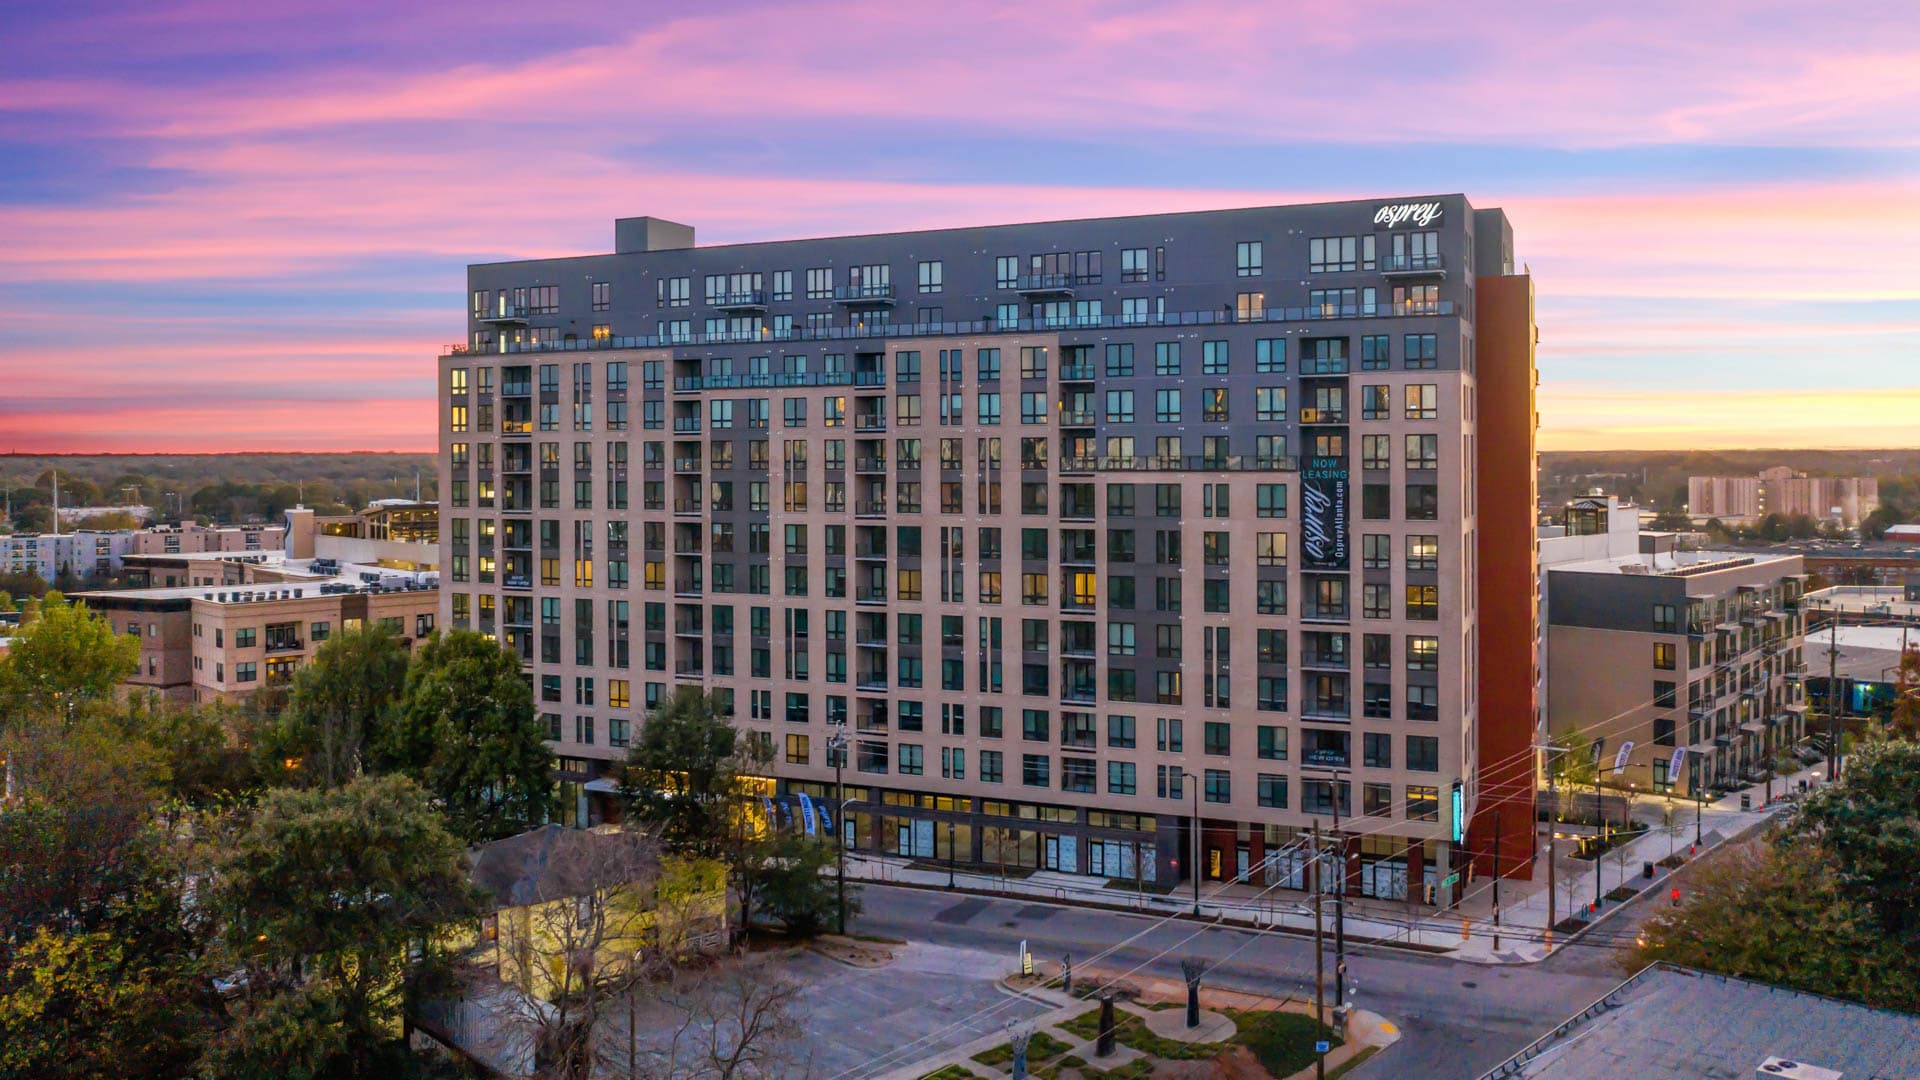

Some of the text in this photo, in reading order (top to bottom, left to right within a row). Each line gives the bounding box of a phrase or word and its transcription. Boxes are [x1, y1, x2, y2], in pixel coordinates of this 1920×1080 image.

[1374, 202, 1443, 228] osprey
[1312, 460, 1336, 468] NOW
[1302, 470, 1348, 479] LEASING
[1304, 481, 1331, 558] osprey
